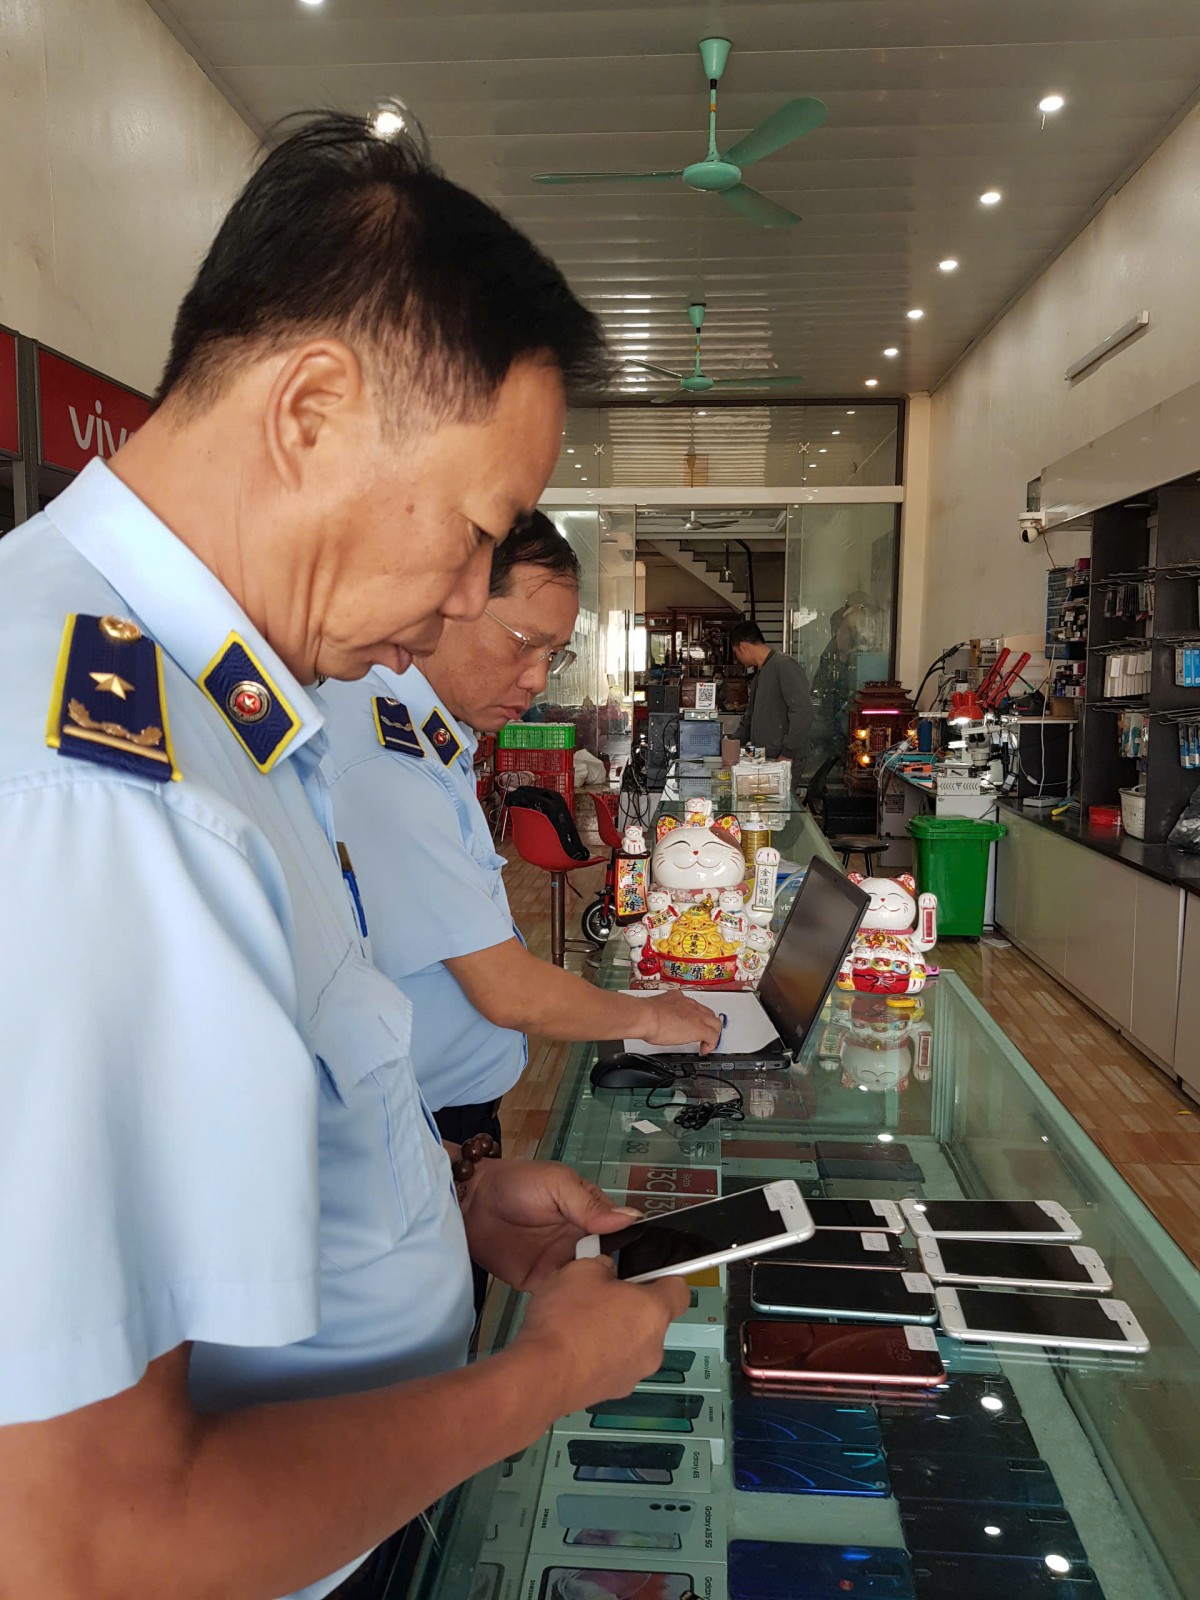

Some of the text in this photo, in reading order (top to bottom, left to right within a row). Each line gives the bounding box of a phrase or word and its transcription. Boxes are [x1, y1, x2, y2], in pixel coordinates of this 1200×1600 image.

[68, 400, 136, 457] viv
[645, 1167, 677, 1192] 13C
[692, 1451, 700, 1470] Galaxy
[541, 1508, 550, 1529] SAMSUNG
[704, 1505, 712, 1527] Galaxy
[704, 1539, 713, 1549] 5G
[527, 1579, 536, 1600] SAMSUN
